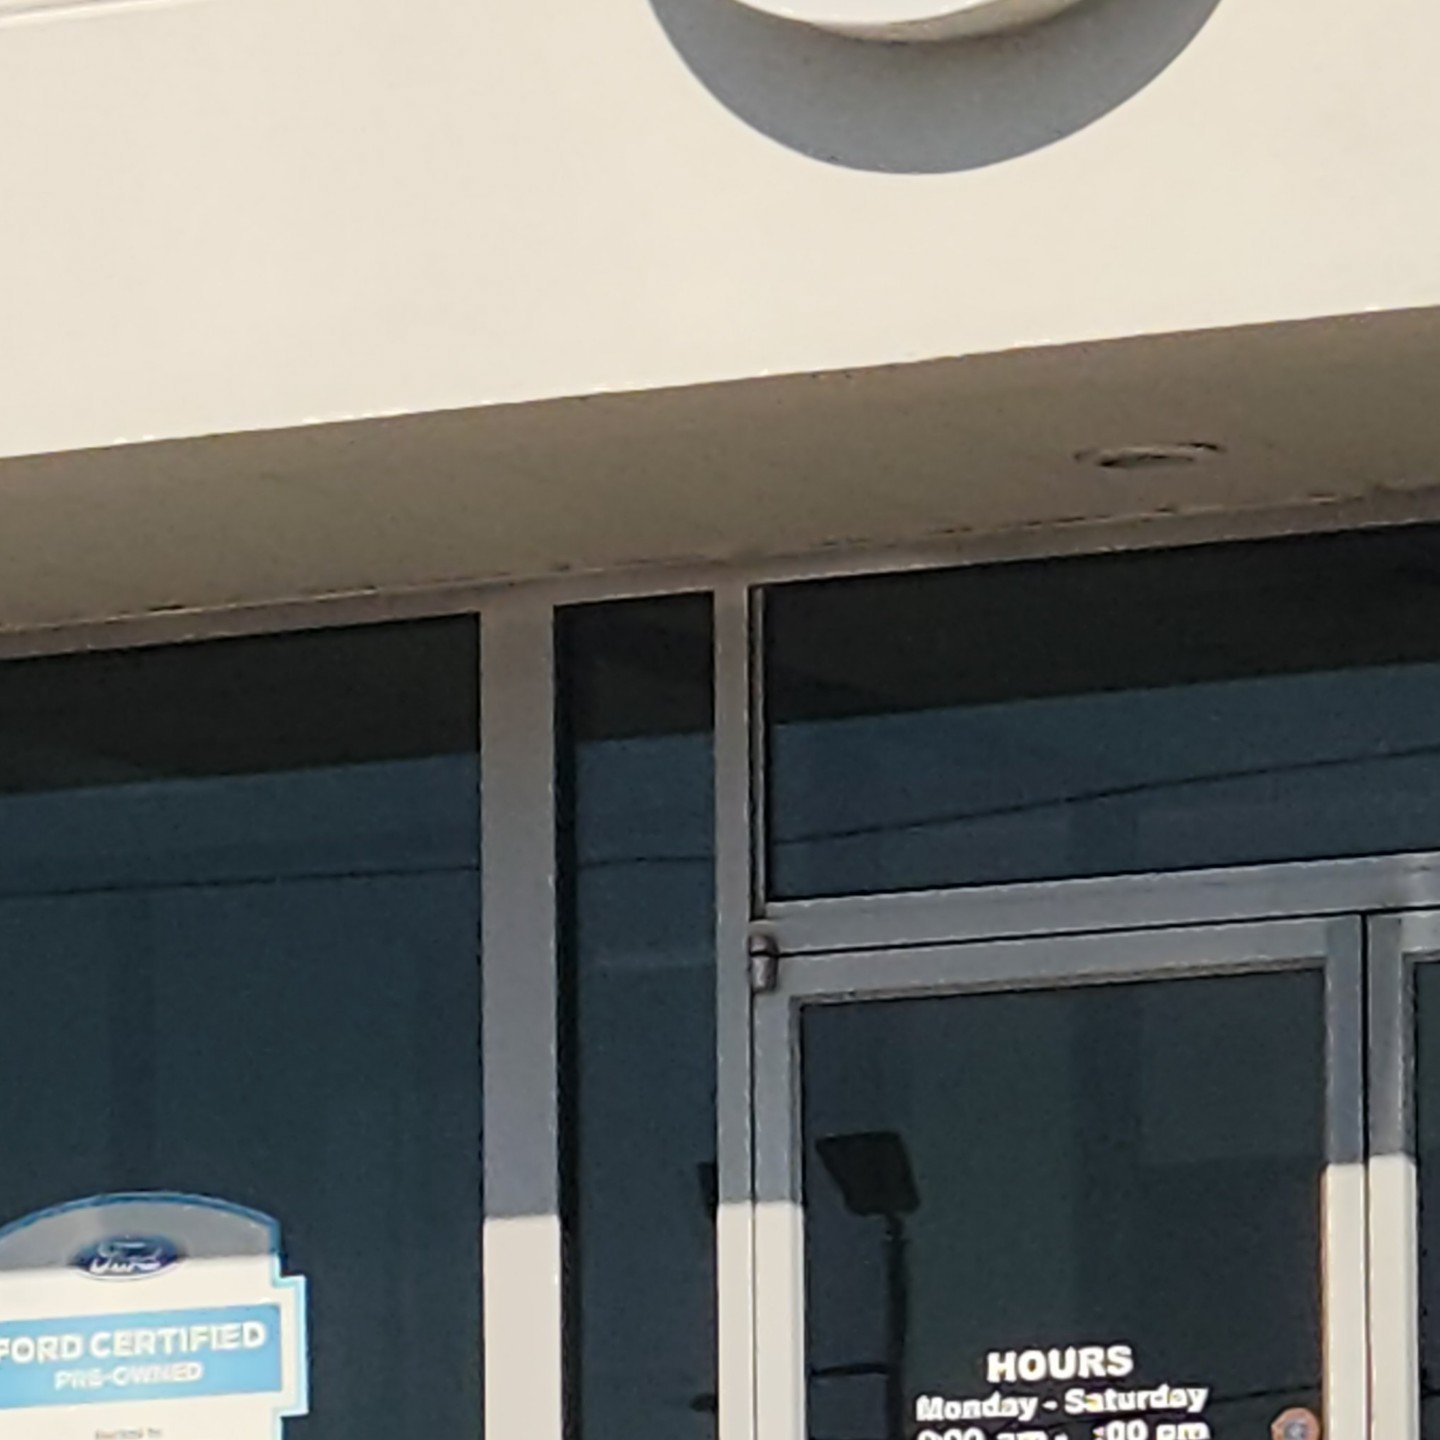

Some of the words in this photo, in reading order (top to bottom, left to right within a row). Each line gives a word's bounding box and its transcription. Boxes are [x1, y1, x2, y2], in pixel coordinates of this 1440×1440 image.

[90, 1321, 267, 1358] CERTIFIED
[54, 1361, 204, 1391] PRE-OWNED
[987, 1345, 1134, 1383] HOURS
[916, 1394, 1038, 1421] Monday
[1065, 1384, 1209, 1414] Saturday
